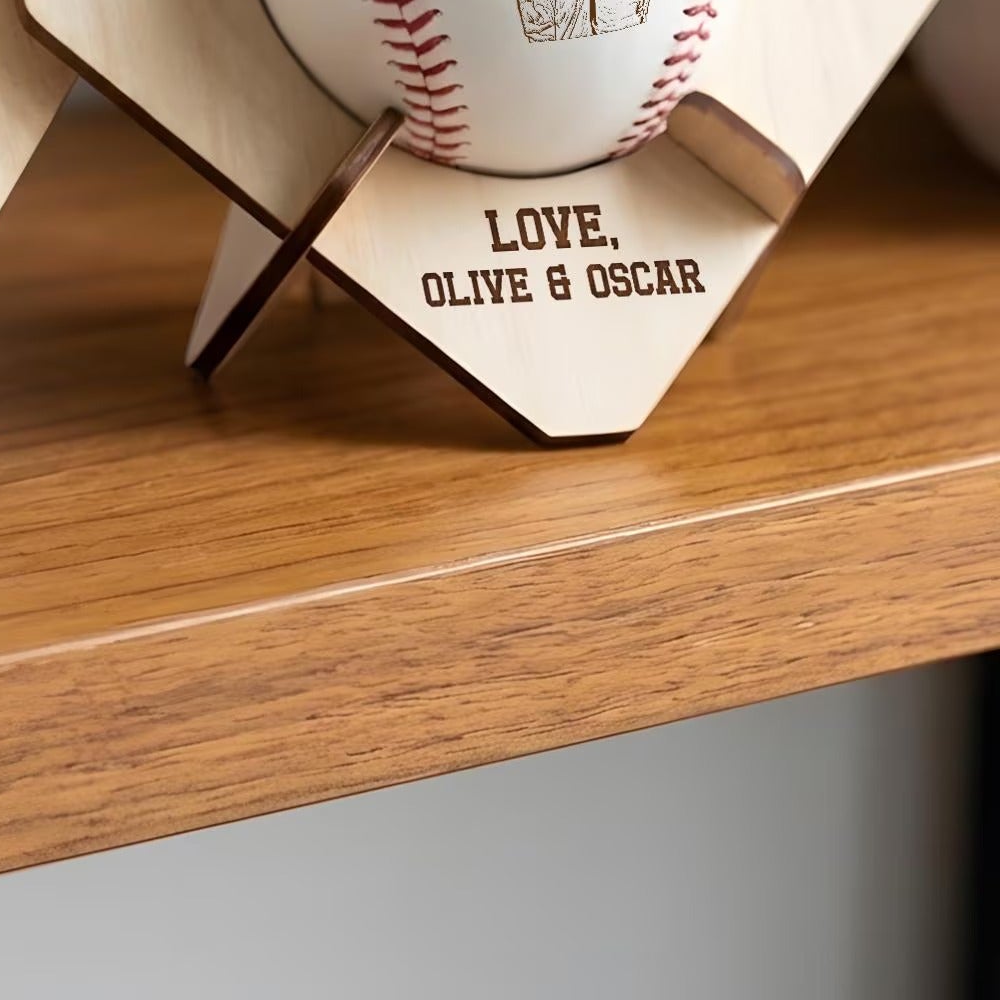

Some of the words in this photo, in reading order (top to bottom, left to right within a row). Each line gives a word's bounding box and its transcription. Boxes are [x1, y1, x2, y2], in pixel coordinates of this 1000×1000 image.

[485, 204, 619, 252] LOVE,
[421, 268, 533, 307] OLIVE
[546, 264, 571, 300] &
[586, 259, 705, 299] OSCAR
